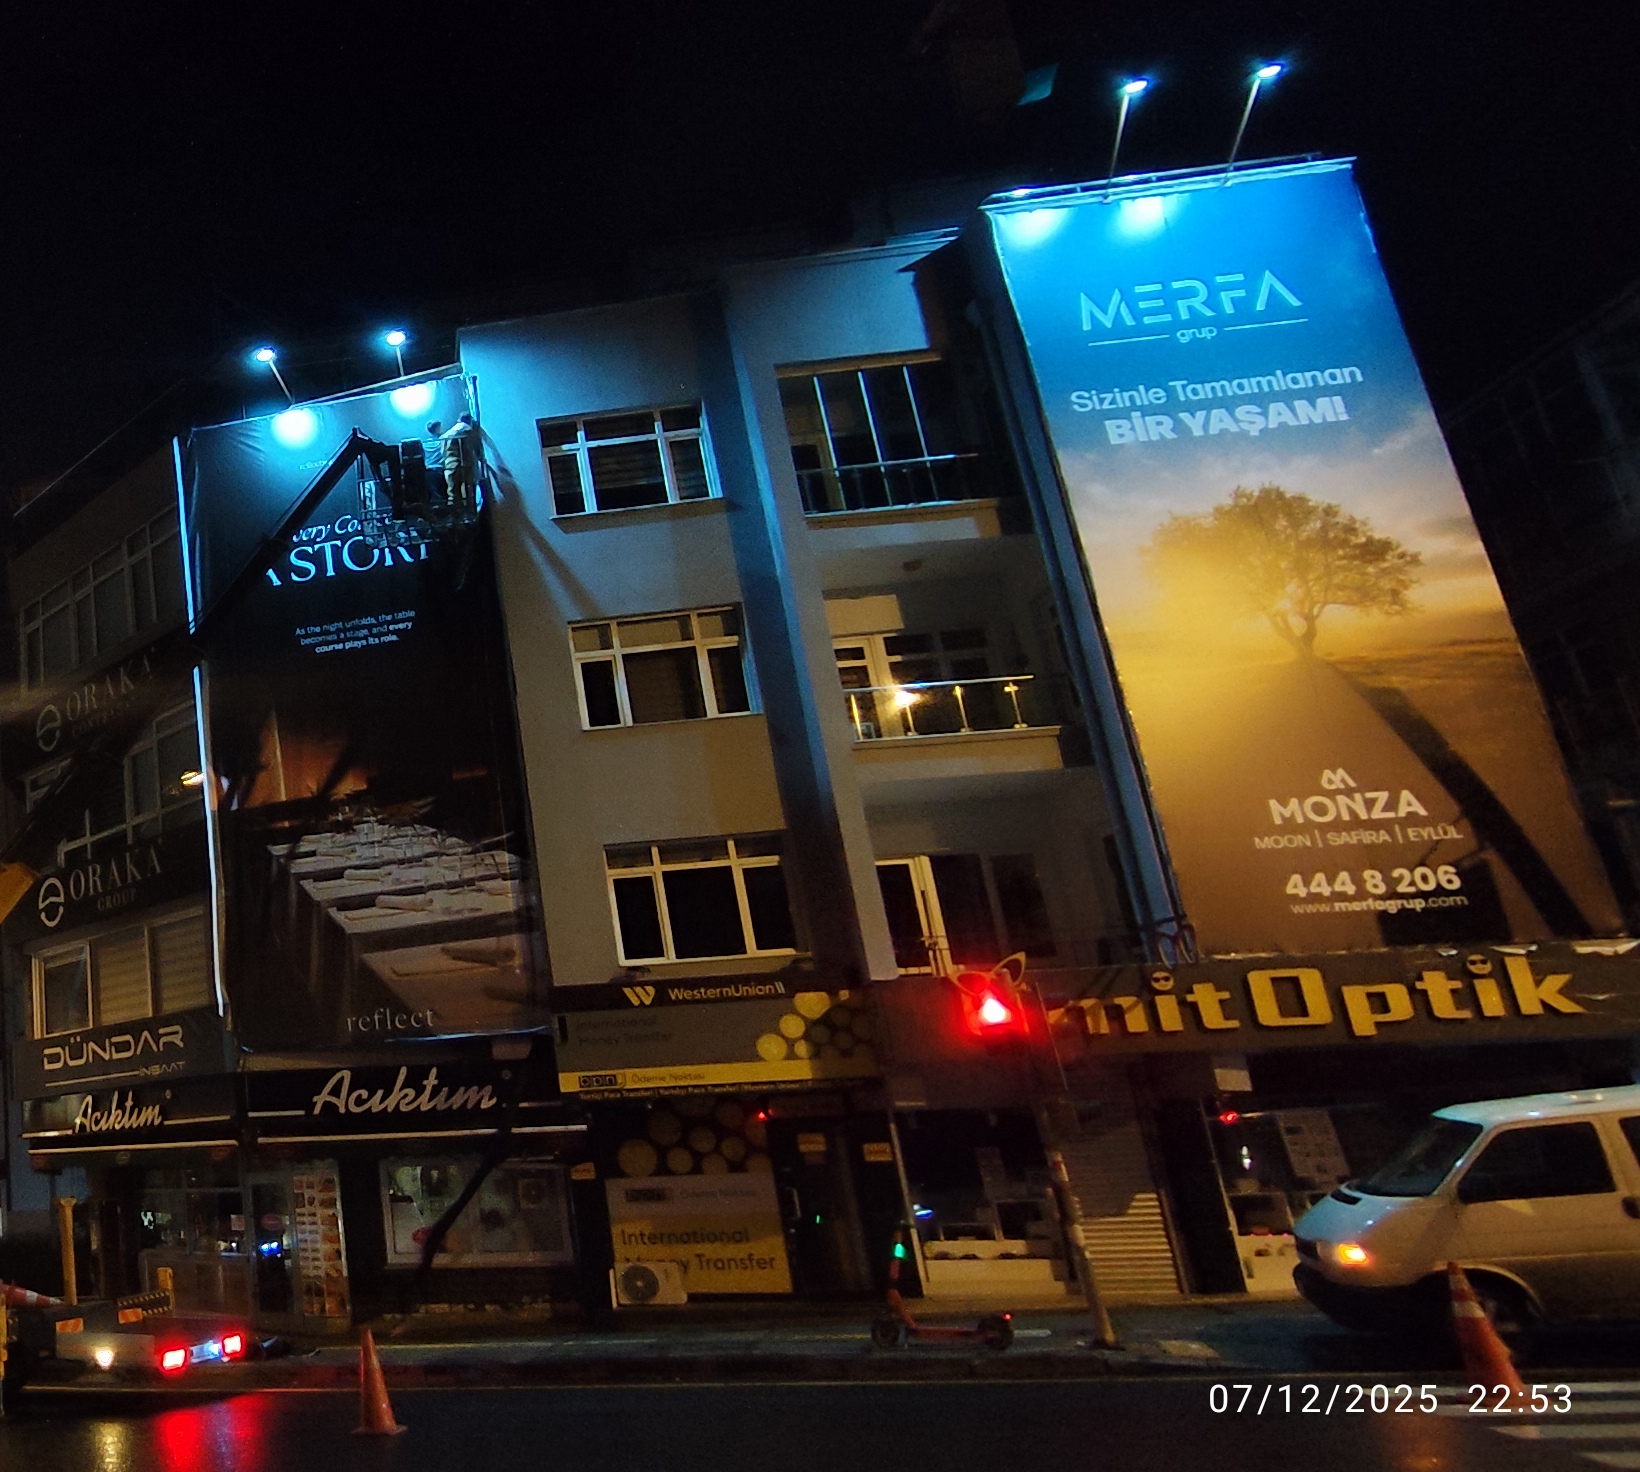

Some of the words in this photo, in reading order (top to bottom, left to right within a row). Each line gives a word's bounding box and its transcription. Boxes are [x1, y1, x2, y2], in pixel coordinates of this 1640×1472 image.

[1079, 269, 1303, 331] MERFA
[1176, 325, 1218, 344] grup
[1070, 384, 1168, 412] Sizinle
[1168, 365, 1365, 402] Tamamlanan
[1104, 410, 1179, 446] BİR
[1178, 395, 1351, 437] YAŞAM!
[295, 627, 306, 637] As
[306, 625, 321, 635] the
[322, 620, 343, 633] night
[378, 613, 393, 623] the
[393, 609, 416, 621] table
[300, 633, 338, 646] becomes
[339, 630, 345, 640] a
[371, 624, 388, 635] and
[388, 621, 413, 632] every
[315, 642, 344, 654] course
[344, 637, 367, 650] plays
[368, 636, 380, 645] its
[1268, 789, 1429, 825] MONZA
[1254, 834, 1313, 850] MOON
[1326, 828, 1393, 846] SAFİRA
[1407, 822, 1464, 842] EYLÜL
[69, 843, 162, 901] ORAKA
[1285, 870, 1357, 898] 444
[1362, 868, 1387, 895] 8
[1391, 864, 1462, 893] 206
[1290, 895, 1470, 914] www.merfagrup.com
[346, 1007, 435, 1032] reflect
[42, 1024, 184, 1070] DÜNDAR
[312, 1065, 498, 1115] Acıktım
[74, 1090, 163, 1134] Acıktım
[621, 1228, 750, 1246] International
[694, 1252, 776, 1272] Transfer
